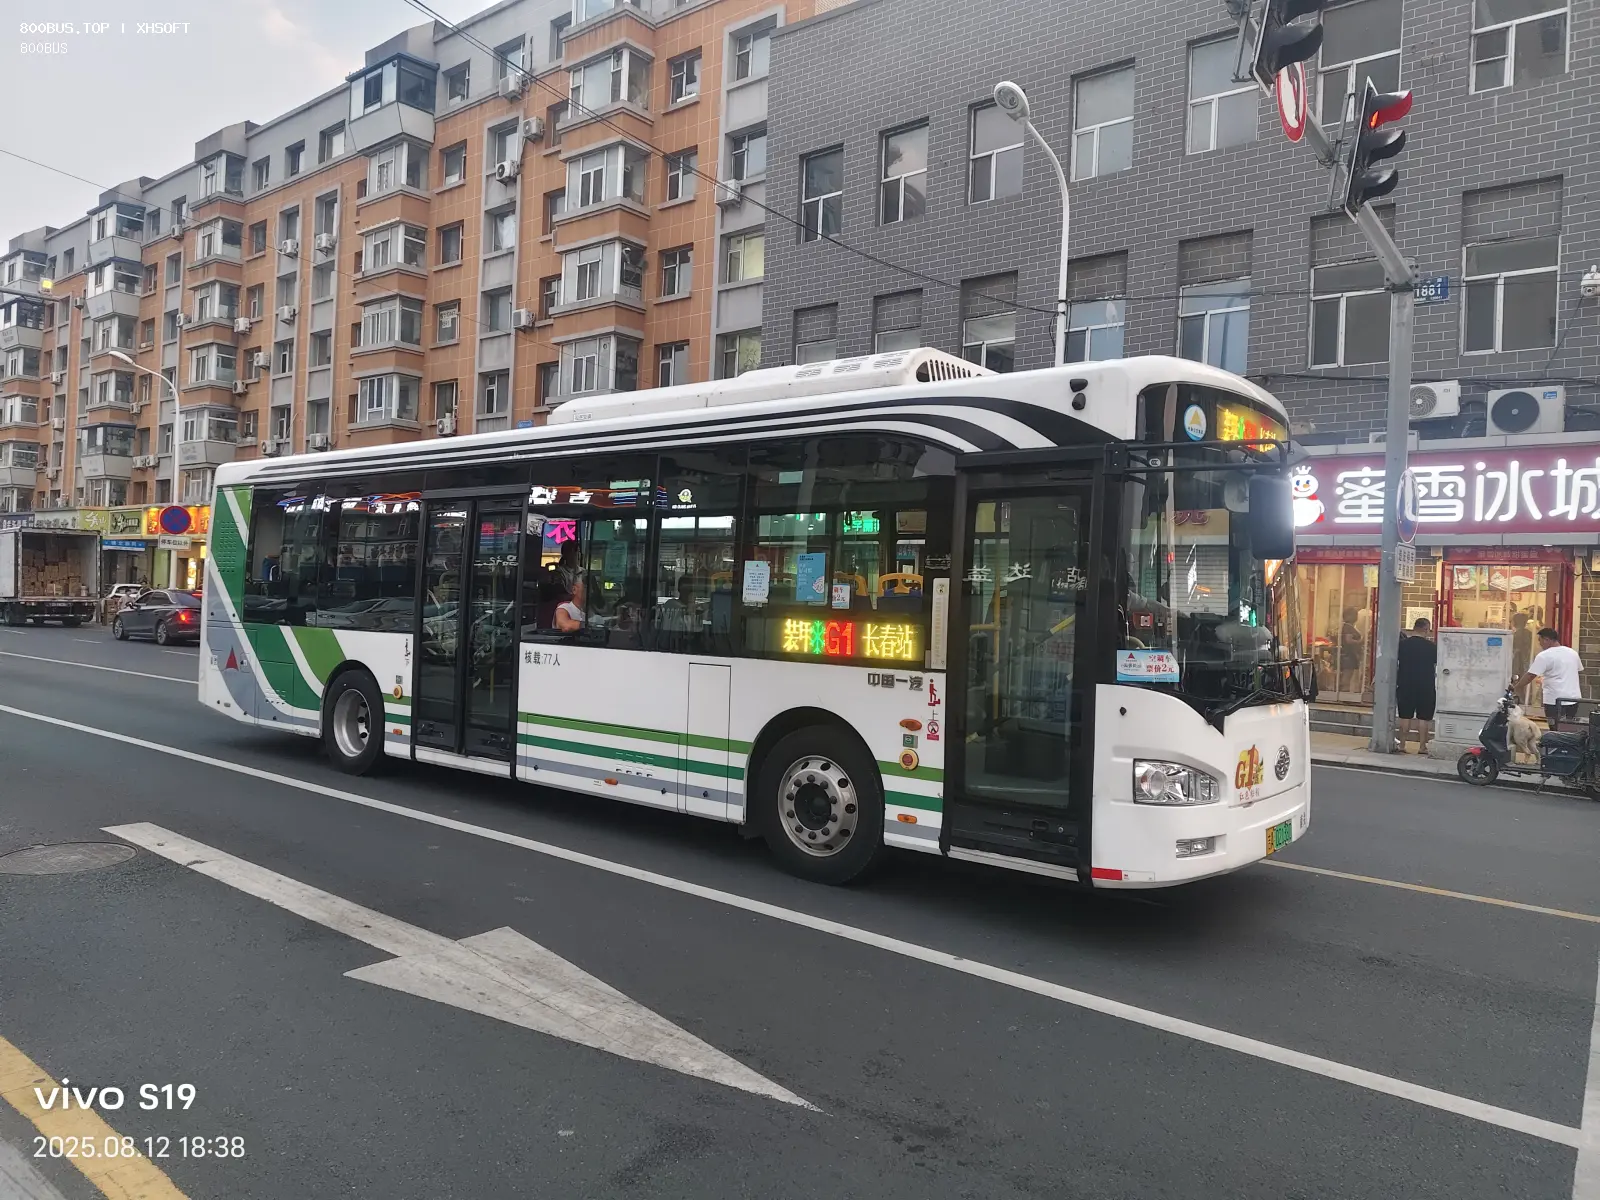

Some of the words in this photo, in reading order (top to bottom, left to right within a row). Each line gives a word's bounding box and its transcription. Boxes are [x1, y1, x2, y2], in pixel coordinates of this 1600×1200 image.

[825, 620, 855, 657] G1
[861, 622, 914, 660] 长春站
[867, 672, 924, 691] 中国一汽
